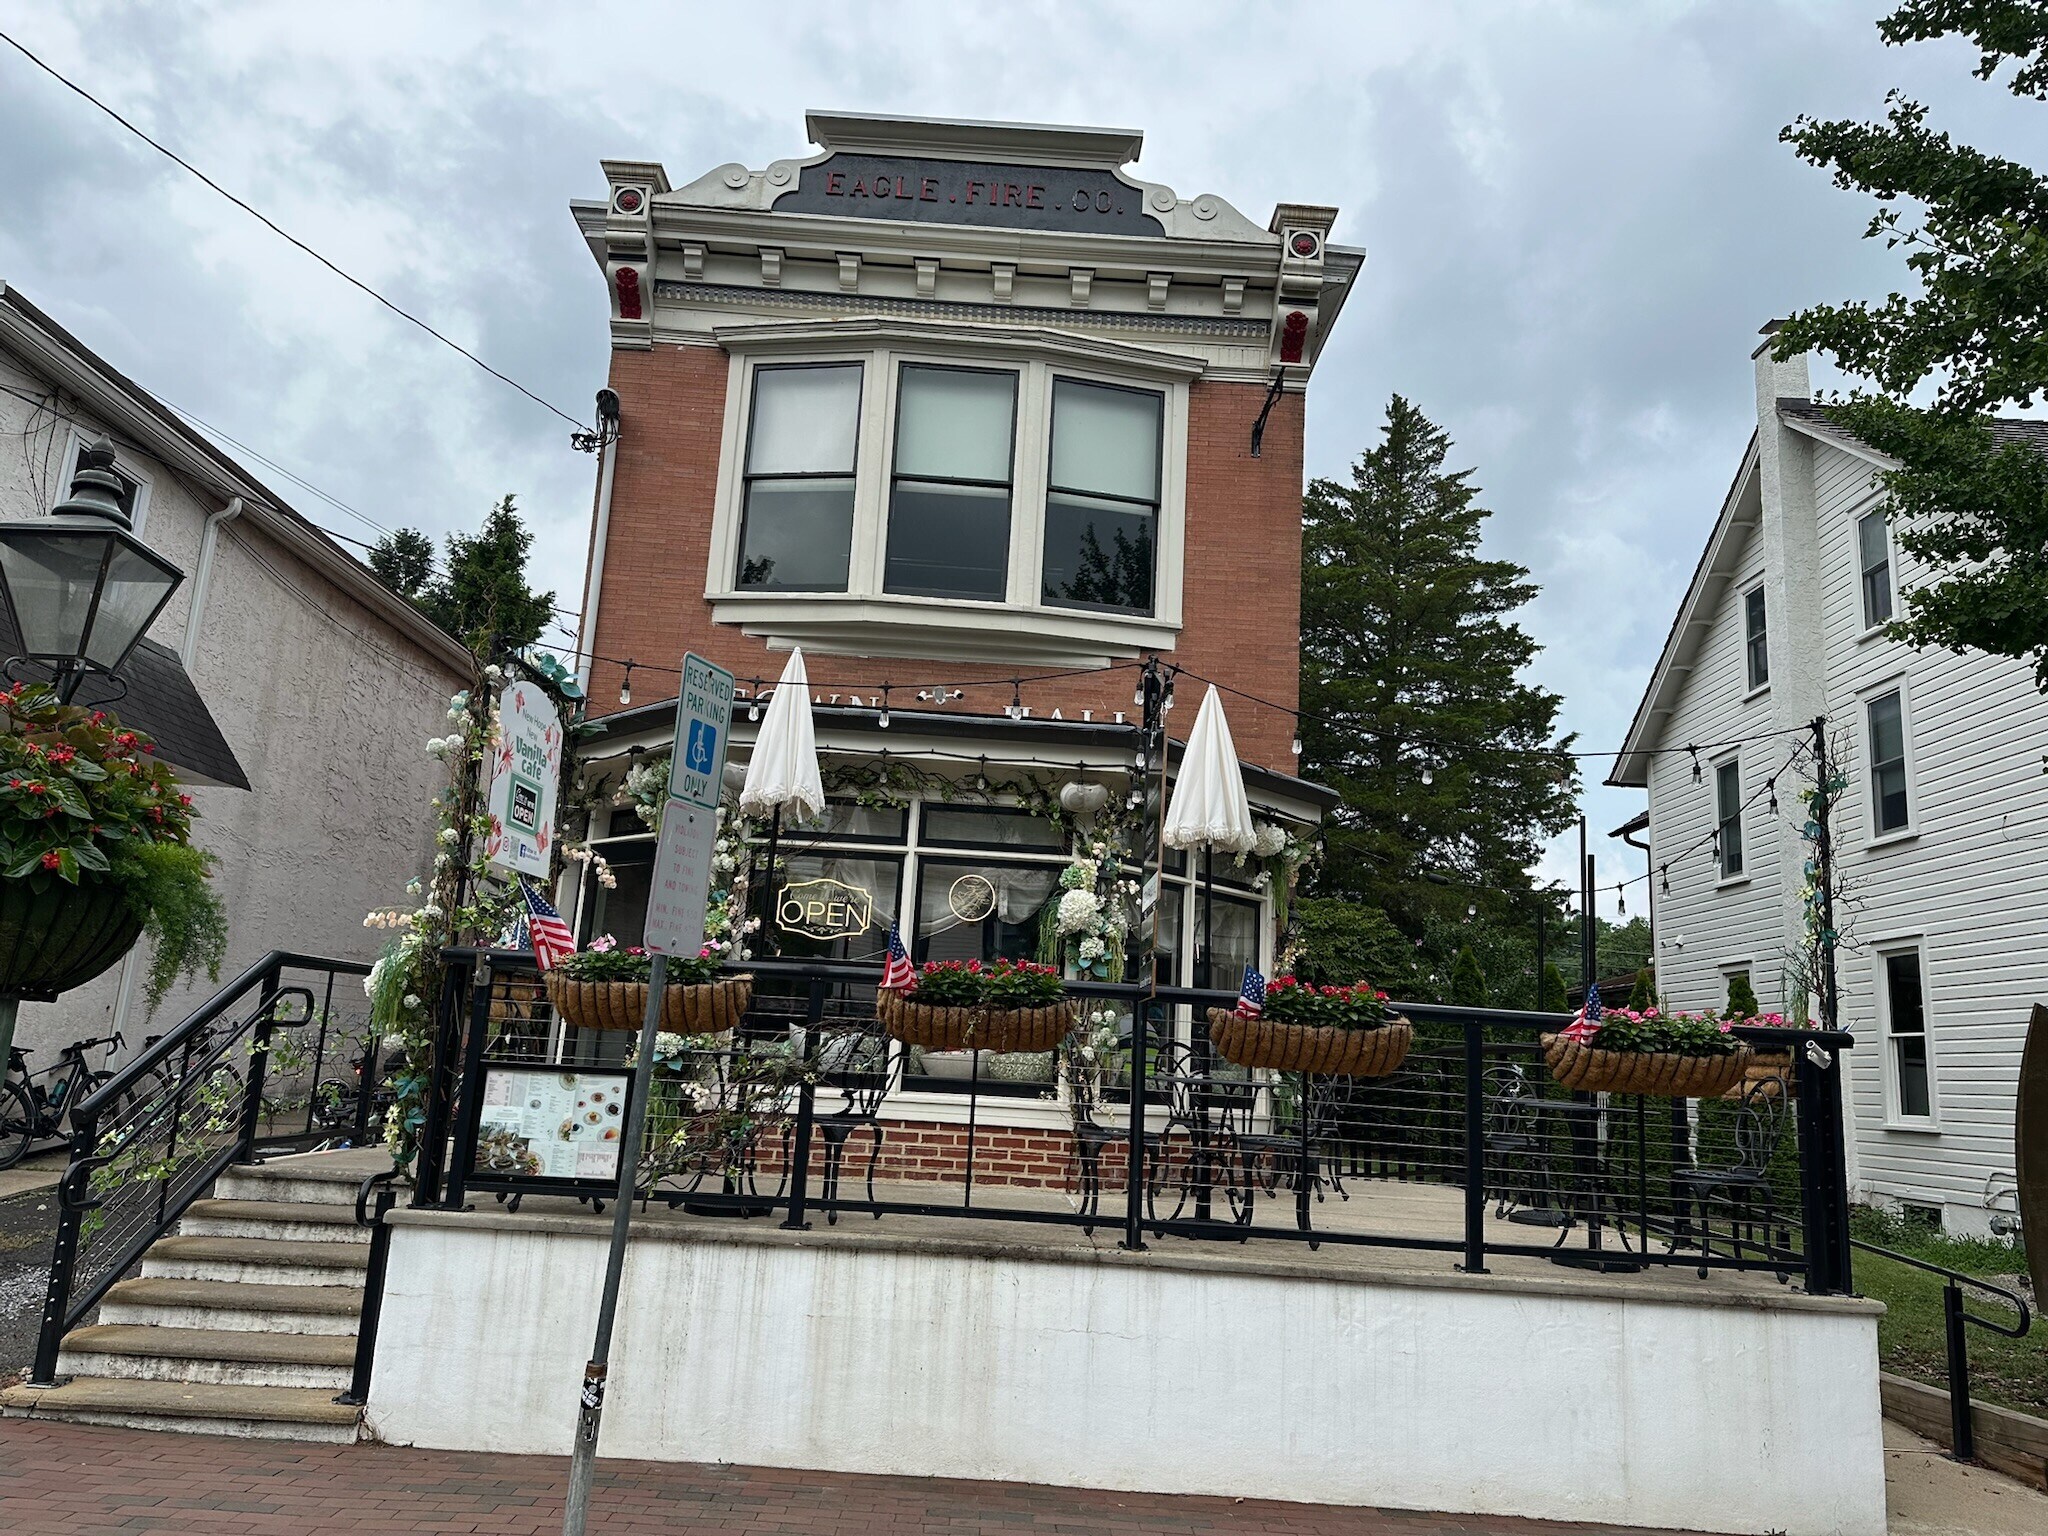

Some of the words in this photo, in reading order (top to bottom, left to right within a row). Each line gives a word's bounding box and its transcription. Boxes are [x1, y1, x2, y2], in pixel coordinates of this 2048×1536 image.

[825, 172, 939, 202] EAGLE
[965, 179, 1045, 210] FIRE
[686, 665, 730, 702] RESERVED
[522, 707, 533, 724] New
[686, 691, 725, 724] PARKING
[516, 735, 547, 769] Vanilla
[521, 758, 542, 781] cafe
[684, 774, 708, 798] ONLY
[513, 804, 535, 825] OPEN
[674, 843, 699, 860] SUBJECT
[664, 879, 677, 891] AND
[781, 899, 867, 928] OPEN
